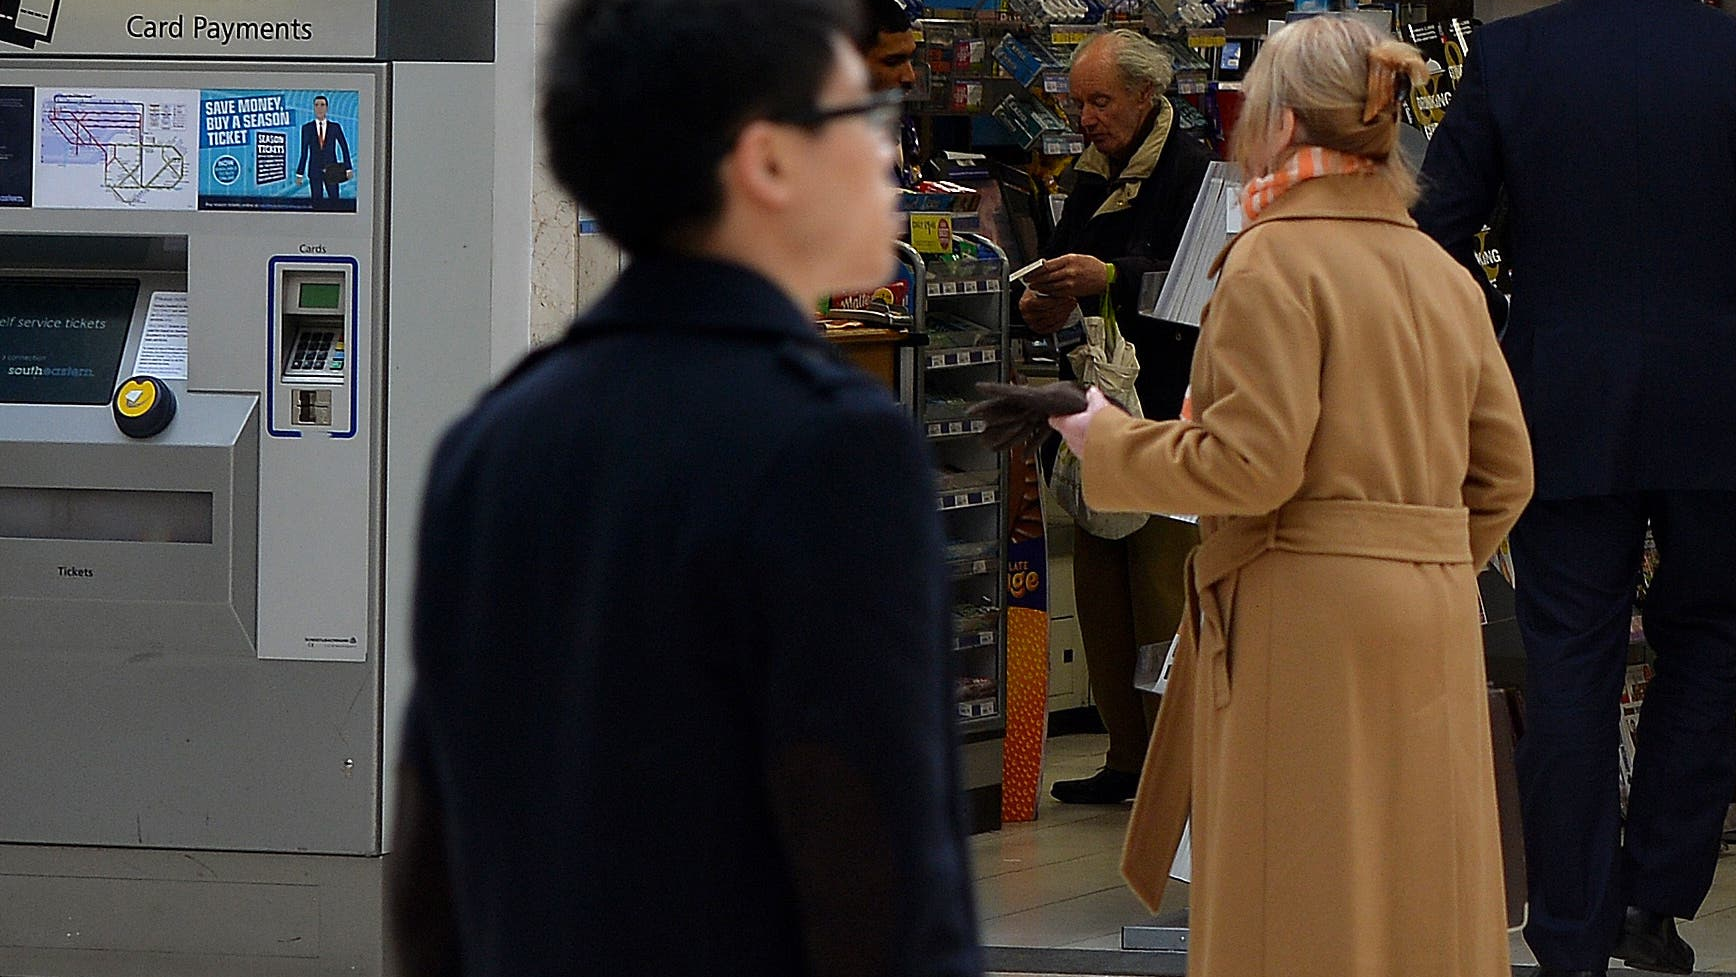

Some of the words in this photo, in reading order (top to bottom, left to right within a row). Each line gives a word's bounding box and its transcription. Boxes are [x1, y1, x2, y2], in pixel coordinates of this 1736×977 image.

[126, 15, 184, 40] Card
[193, 16, 313, 45] Payments
[205, 99, 236, 115] SAVE
[238, 96, 284, 113] MONEY,
[206, 116, 230, 131] BUY
[232, 115, 241, 129] A
[244, 111, 290, 127] SEASON
[207, 130, 248, 146] TICKET
[299, 243, 327, 255] Cards
[0, 317, 16, 328] elf
[17, 317, 61, 329] service
[65, 318, 106, 330] tickets
[57, 566, 94, 578] Tickets
